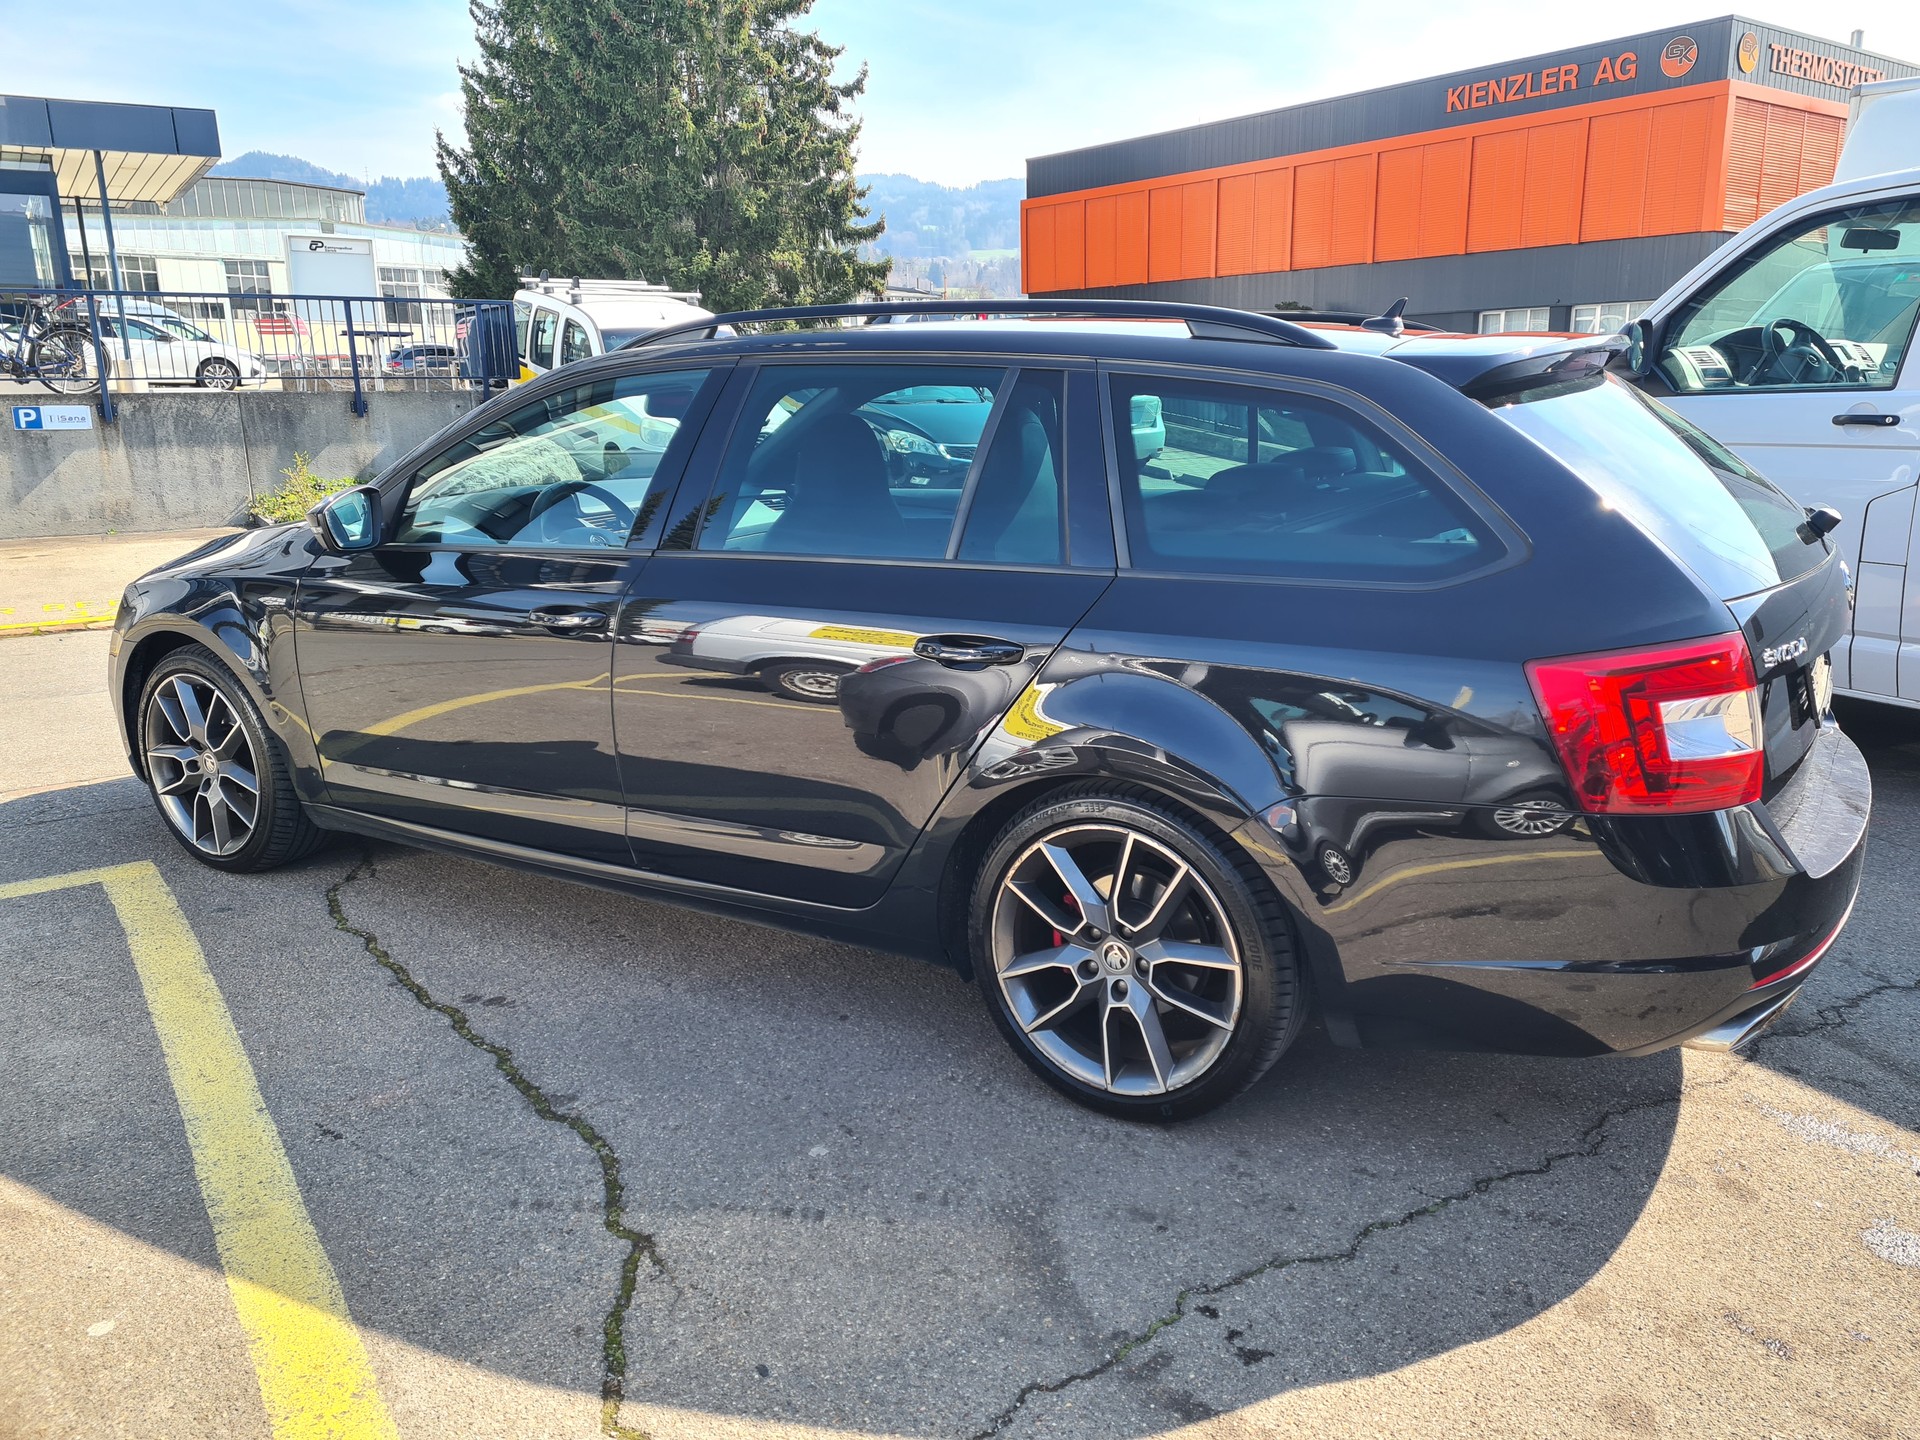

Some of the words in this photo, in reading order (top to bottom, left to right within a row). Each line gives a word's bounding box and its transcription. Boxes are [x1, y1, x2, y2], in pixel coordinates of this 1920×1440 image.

[1445, 64, 1580, 113] KIENZLER
[1592, 51, 1638, 86] AG
[18, 409, 37, 429] P
